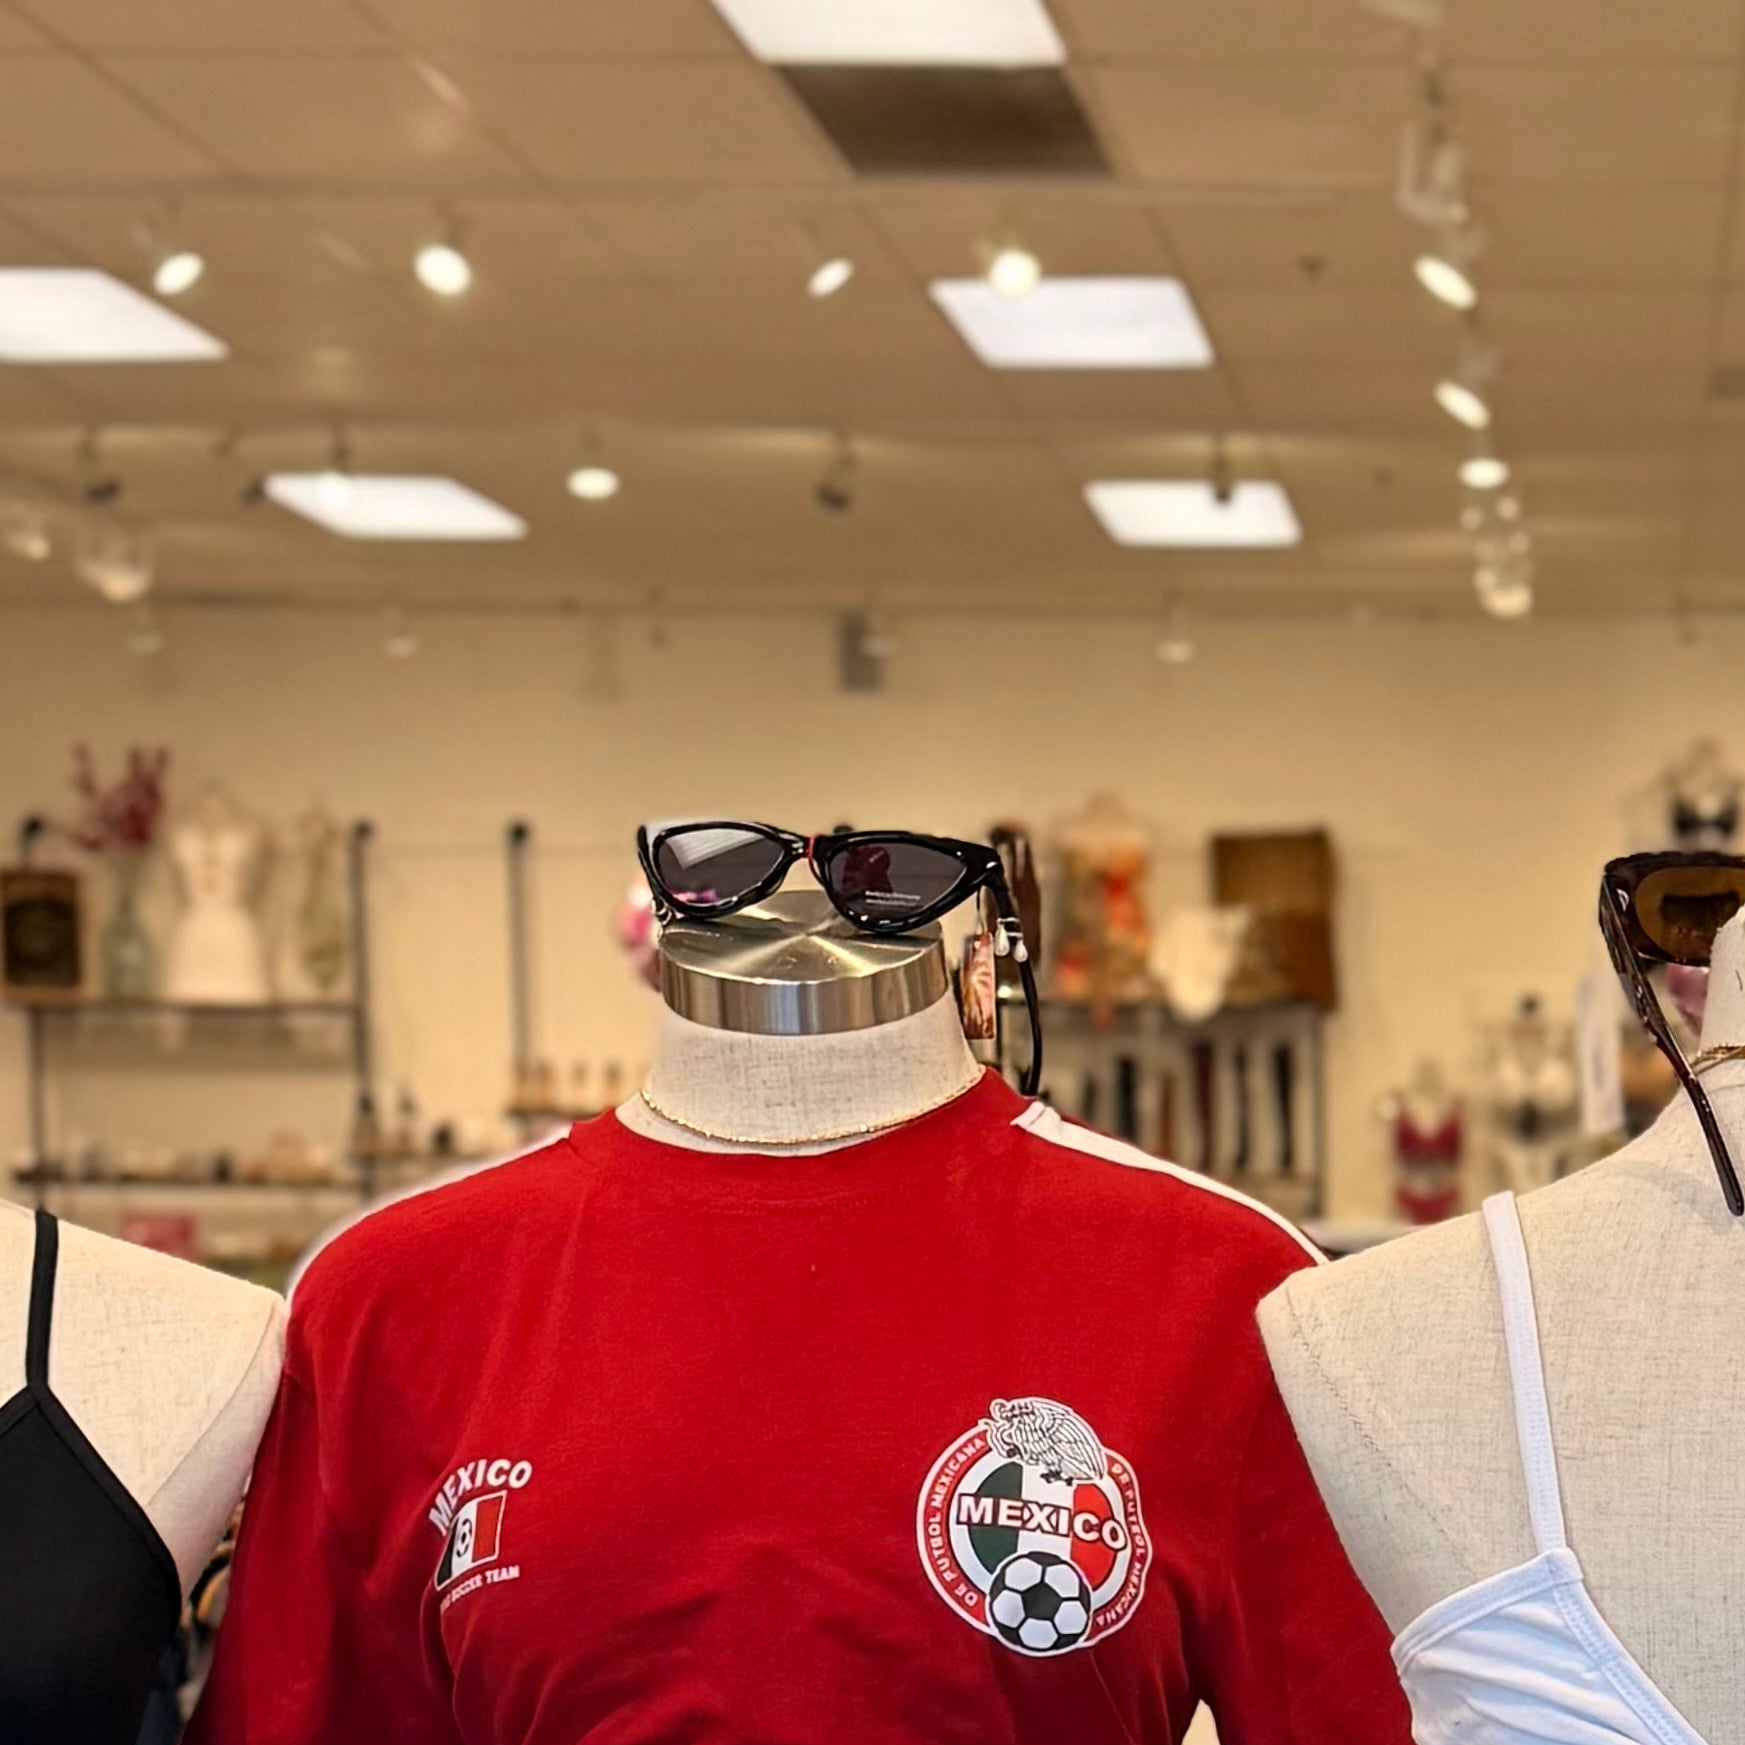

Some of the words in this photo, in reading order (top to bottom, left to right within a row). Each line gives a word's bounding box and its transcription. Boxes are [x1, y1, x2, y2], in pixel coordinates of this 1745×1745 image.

[428, 1459, 533, 1537] MEXICO
[931, 1437, 985, 1508] MEXICANA
[928, 1513, 957, 1582] FUTBOL
[958, 1494, 1127, 1550] MEXICO
[485, 1565, 520, 1584] TEAM
[954, 1583, 978, 1607] DE
